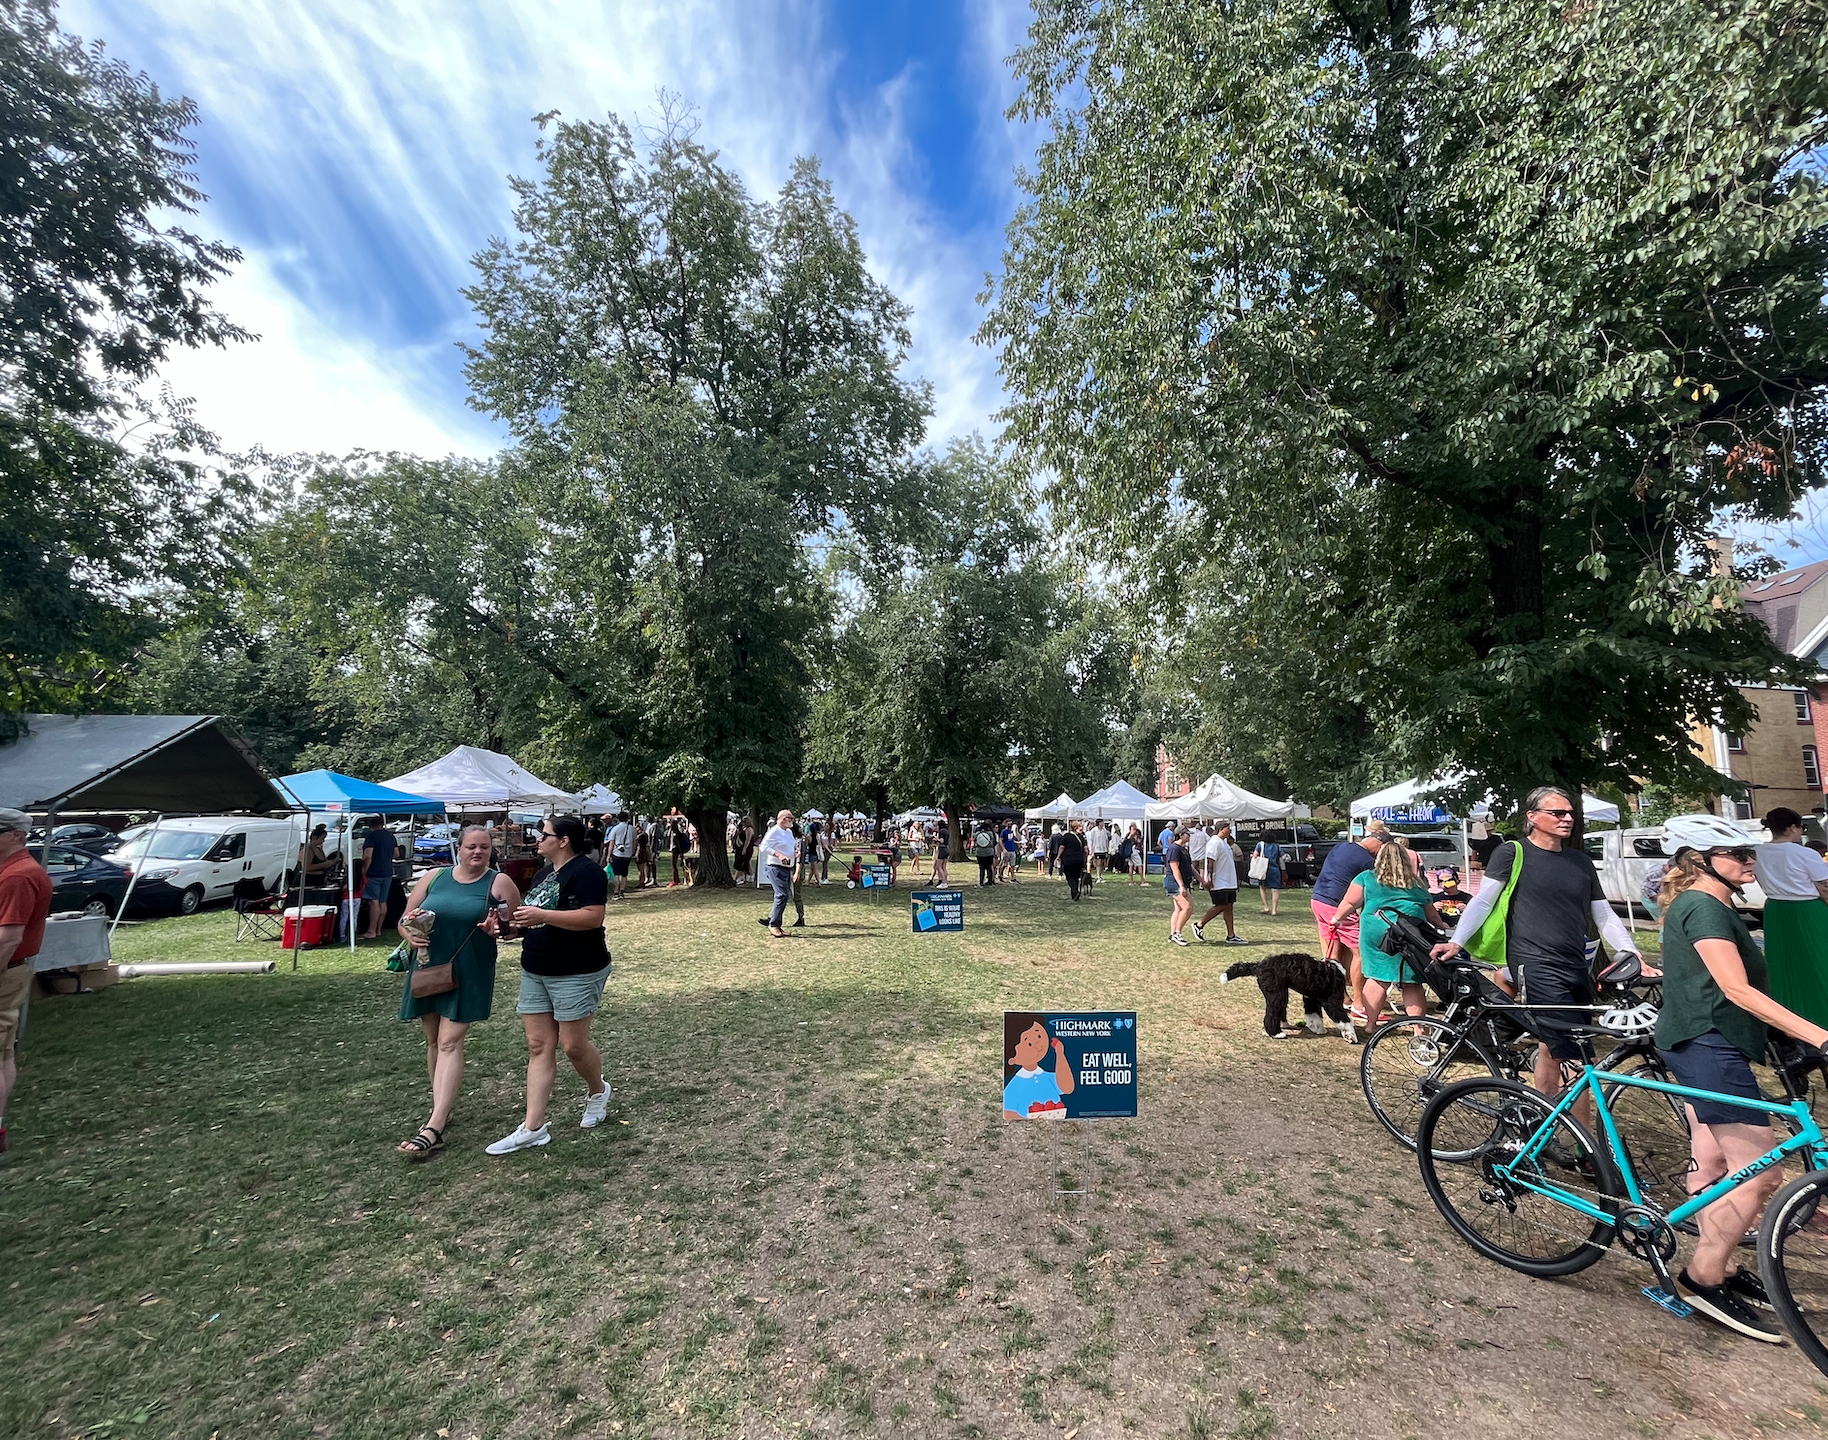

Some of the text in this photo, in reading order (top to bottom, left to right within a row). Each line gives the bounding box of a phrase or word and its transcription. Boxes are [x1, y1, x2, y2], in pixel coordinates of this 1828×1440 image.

[1236, 822, 1260, 831] BARREL
[1265, 821, 1285, 830] BRINE
[1055, 1020, 1111, 1030] HIGHMARK
[1083, 1053, 1132, 1068] EAT WELL,
[1080, 1070, 1132, 1085] FEEL GOOD
[1730, 1152, 1776, 1184] SURLY
